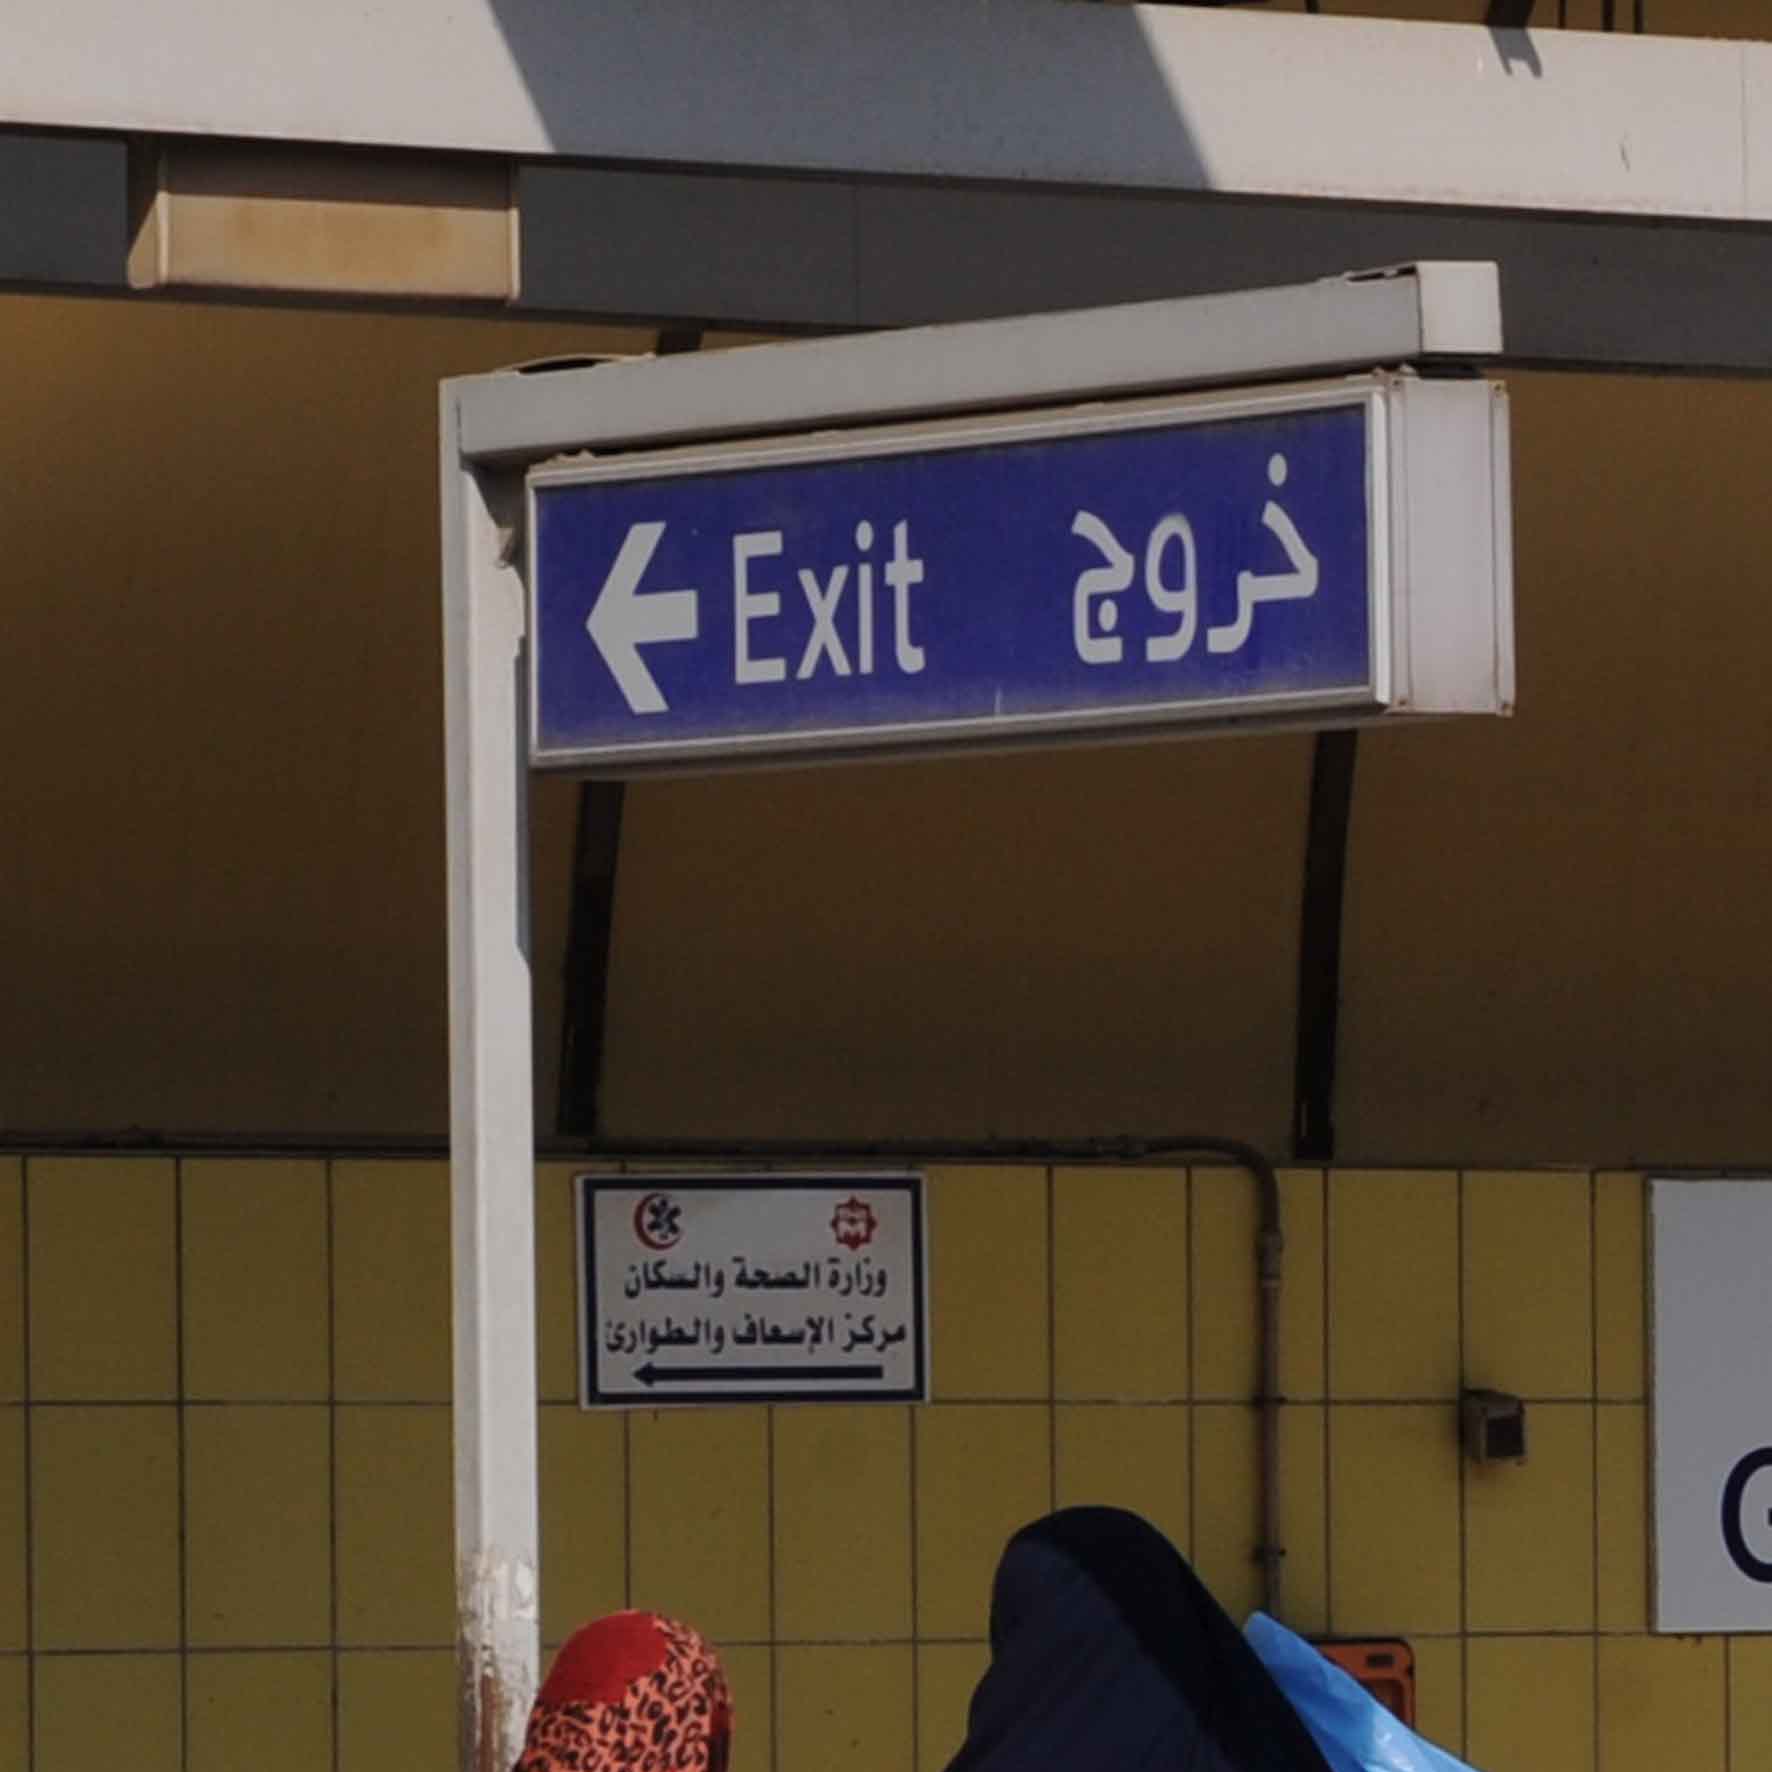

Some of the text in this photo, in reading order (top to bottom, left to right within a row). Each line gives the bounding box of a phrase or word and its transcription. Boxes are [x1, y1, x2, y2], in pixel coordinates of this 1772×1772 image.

[733, 519, 927, 686] Exit
[1071, 453, 1320, 665] خروج
[623, 1256, 888, 1300] وزارة الصحة والسكان
[605, 1312, 908, 1355] مركز الإسعاف والطوارئ
